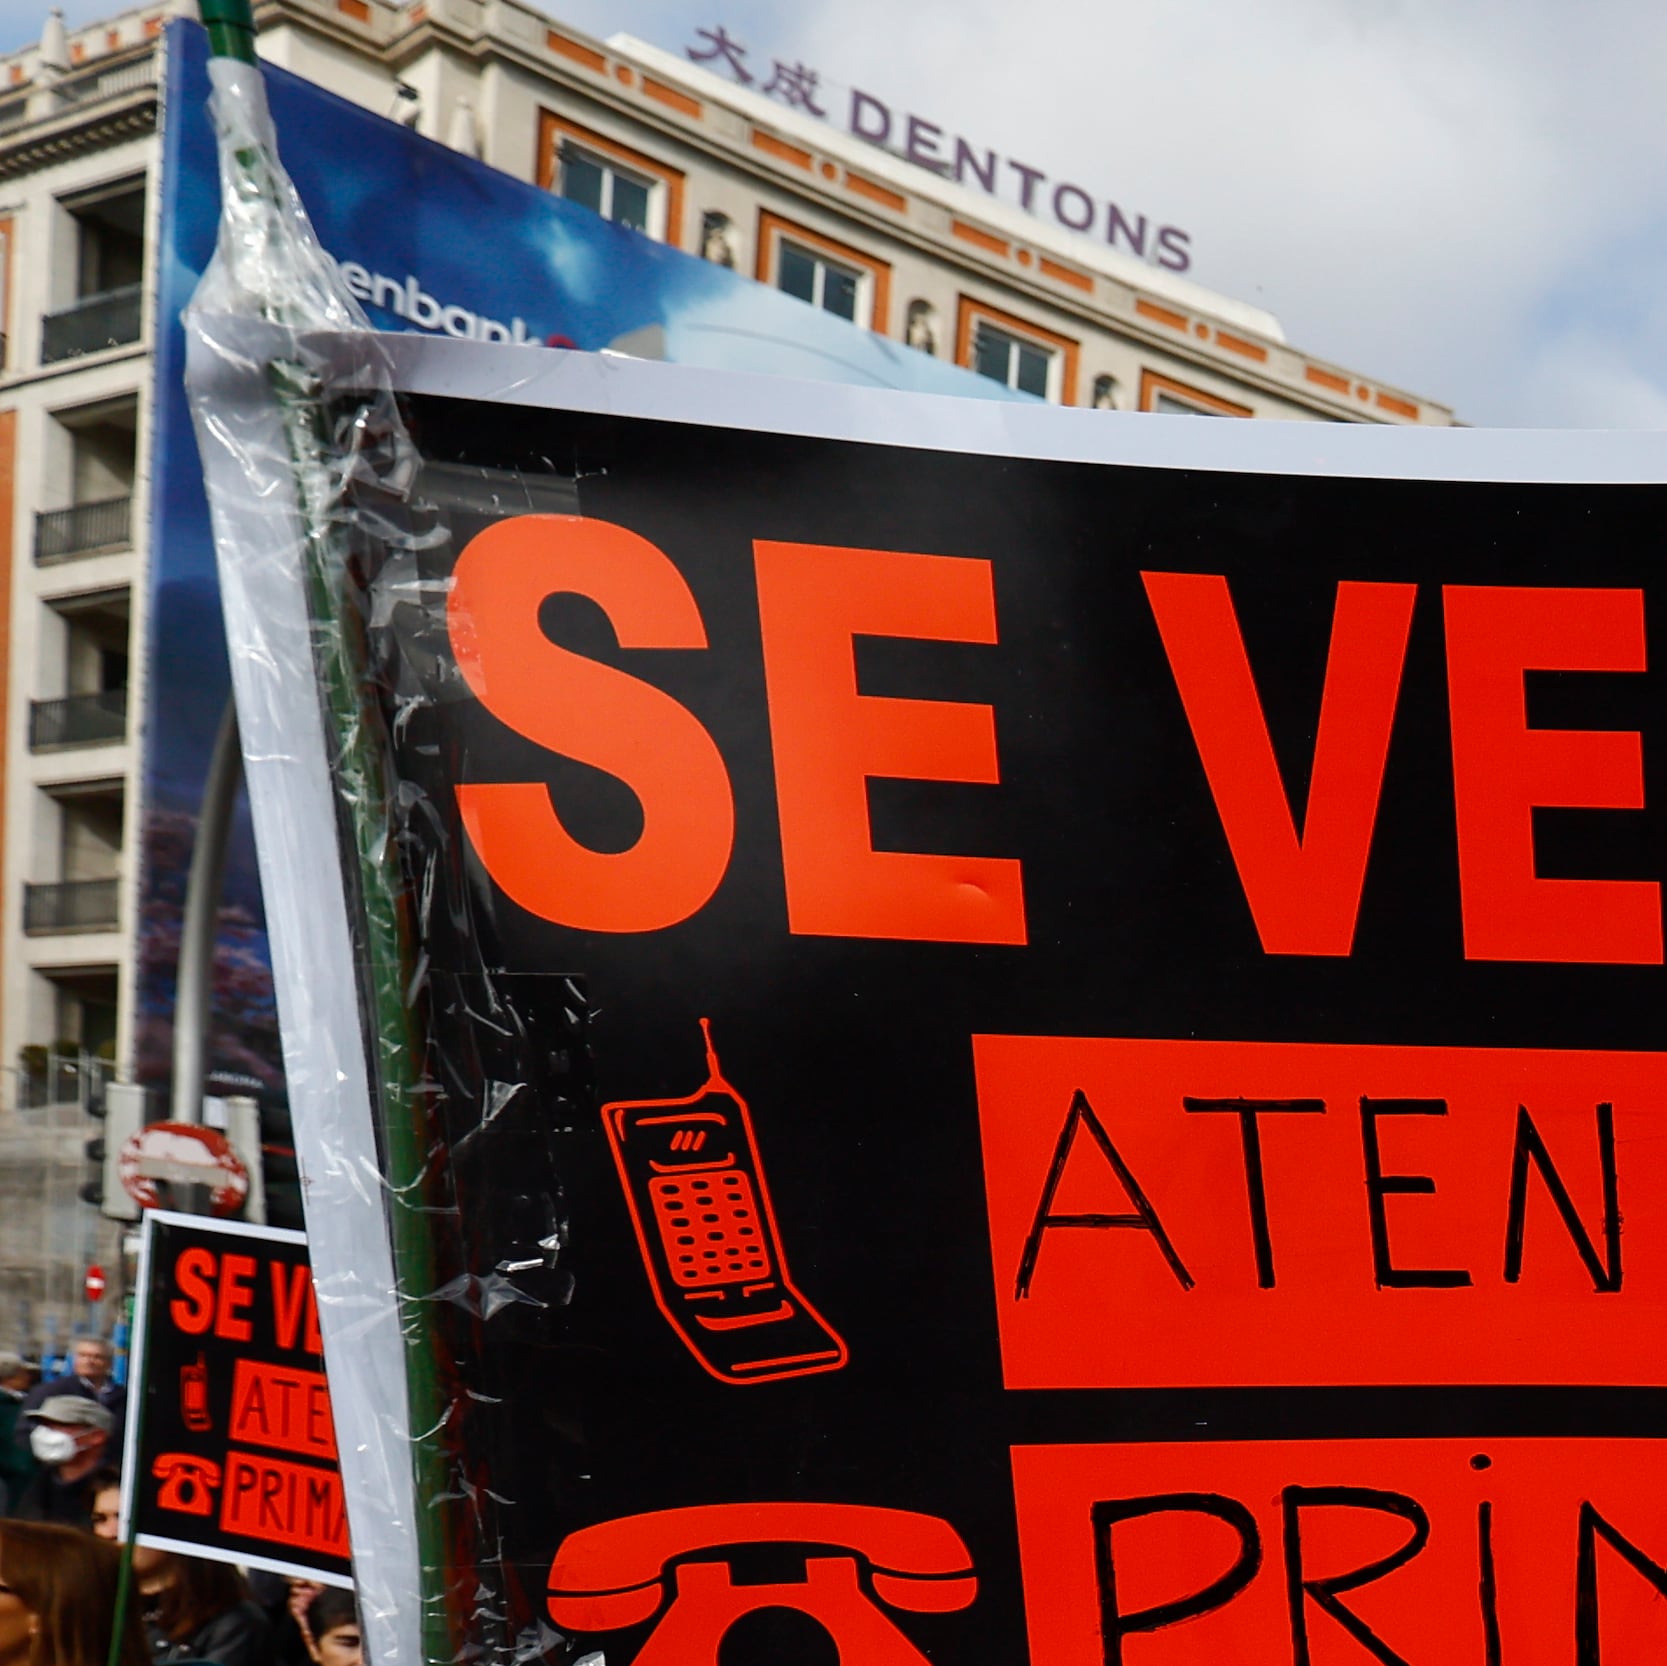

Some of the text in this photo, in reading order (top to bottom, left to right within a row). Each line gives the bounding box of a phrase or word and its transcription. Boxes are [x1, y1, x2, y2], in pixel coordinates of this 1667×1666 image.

[849, 88, 1192, 272] DENTONS
[451, 513, 1029, 947] SE
[169, 1247, 257, 1342] SE
